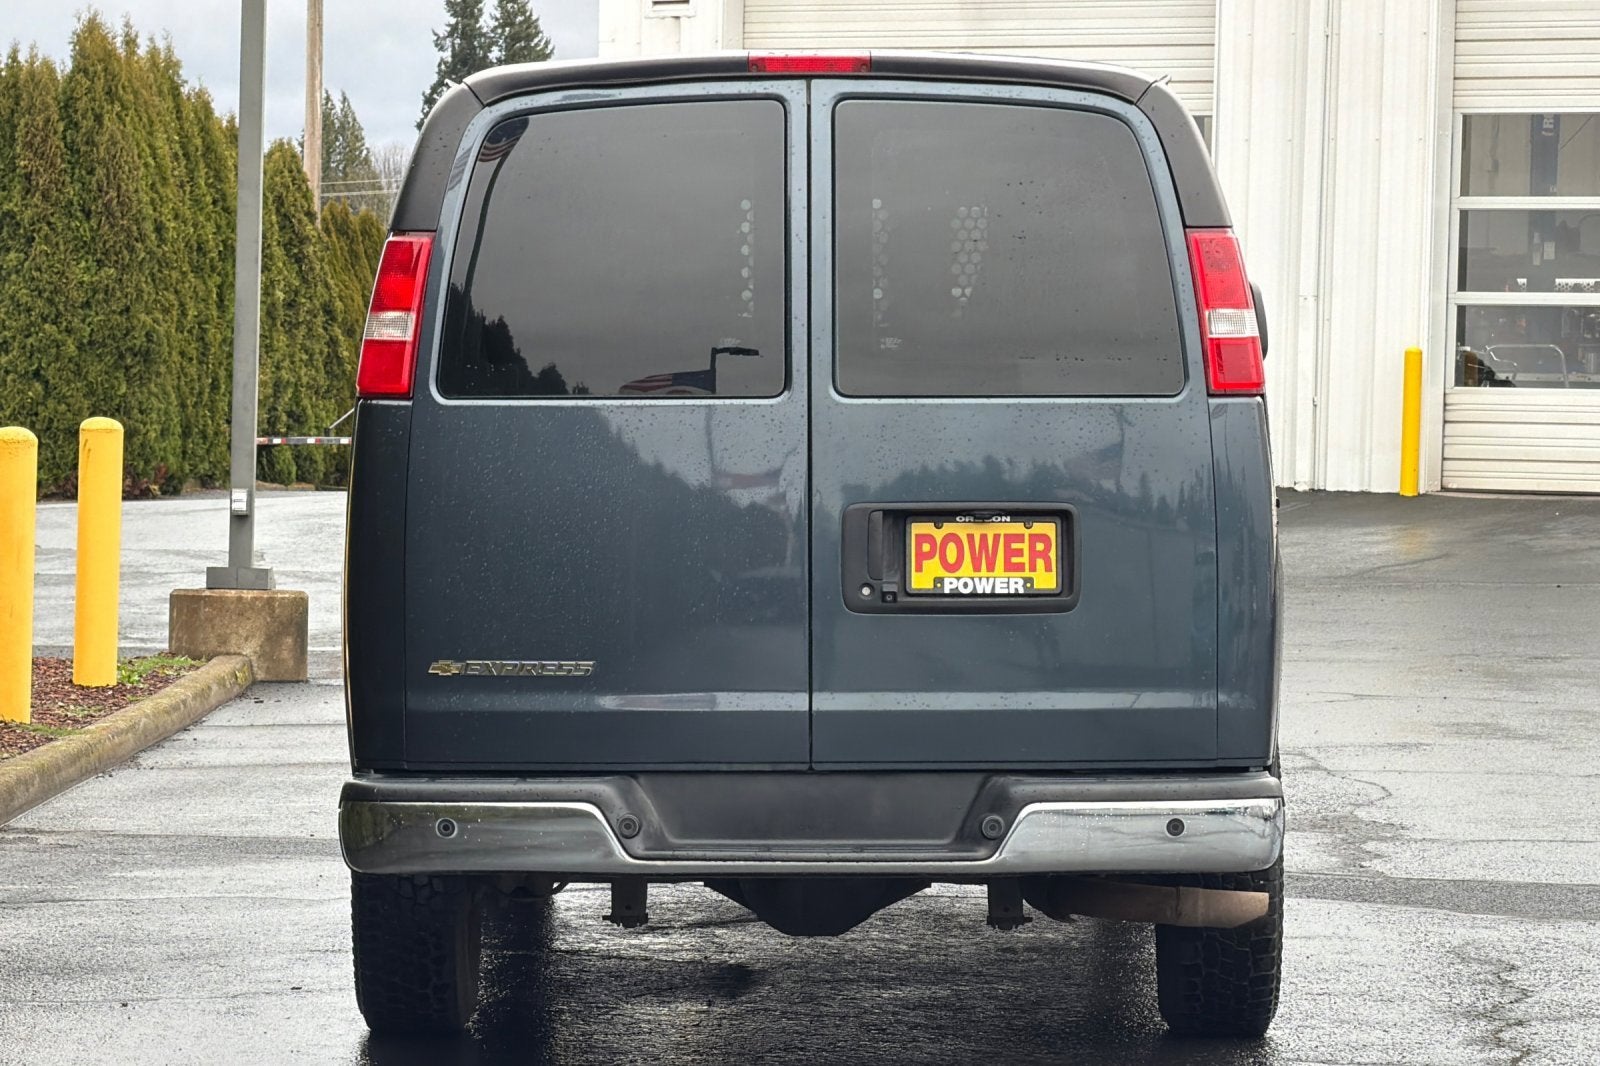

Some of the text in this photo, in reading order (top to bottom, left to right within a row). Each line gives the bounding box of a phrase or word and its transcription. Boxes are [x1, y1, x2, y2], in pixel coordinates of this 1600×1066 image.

[956, 515, 1011, 523] ORON
[914, 532, 1053, 573] POWER
[943, 577, 1025, 594] POWER
[463, 660, 595, 676] EXPRESS
